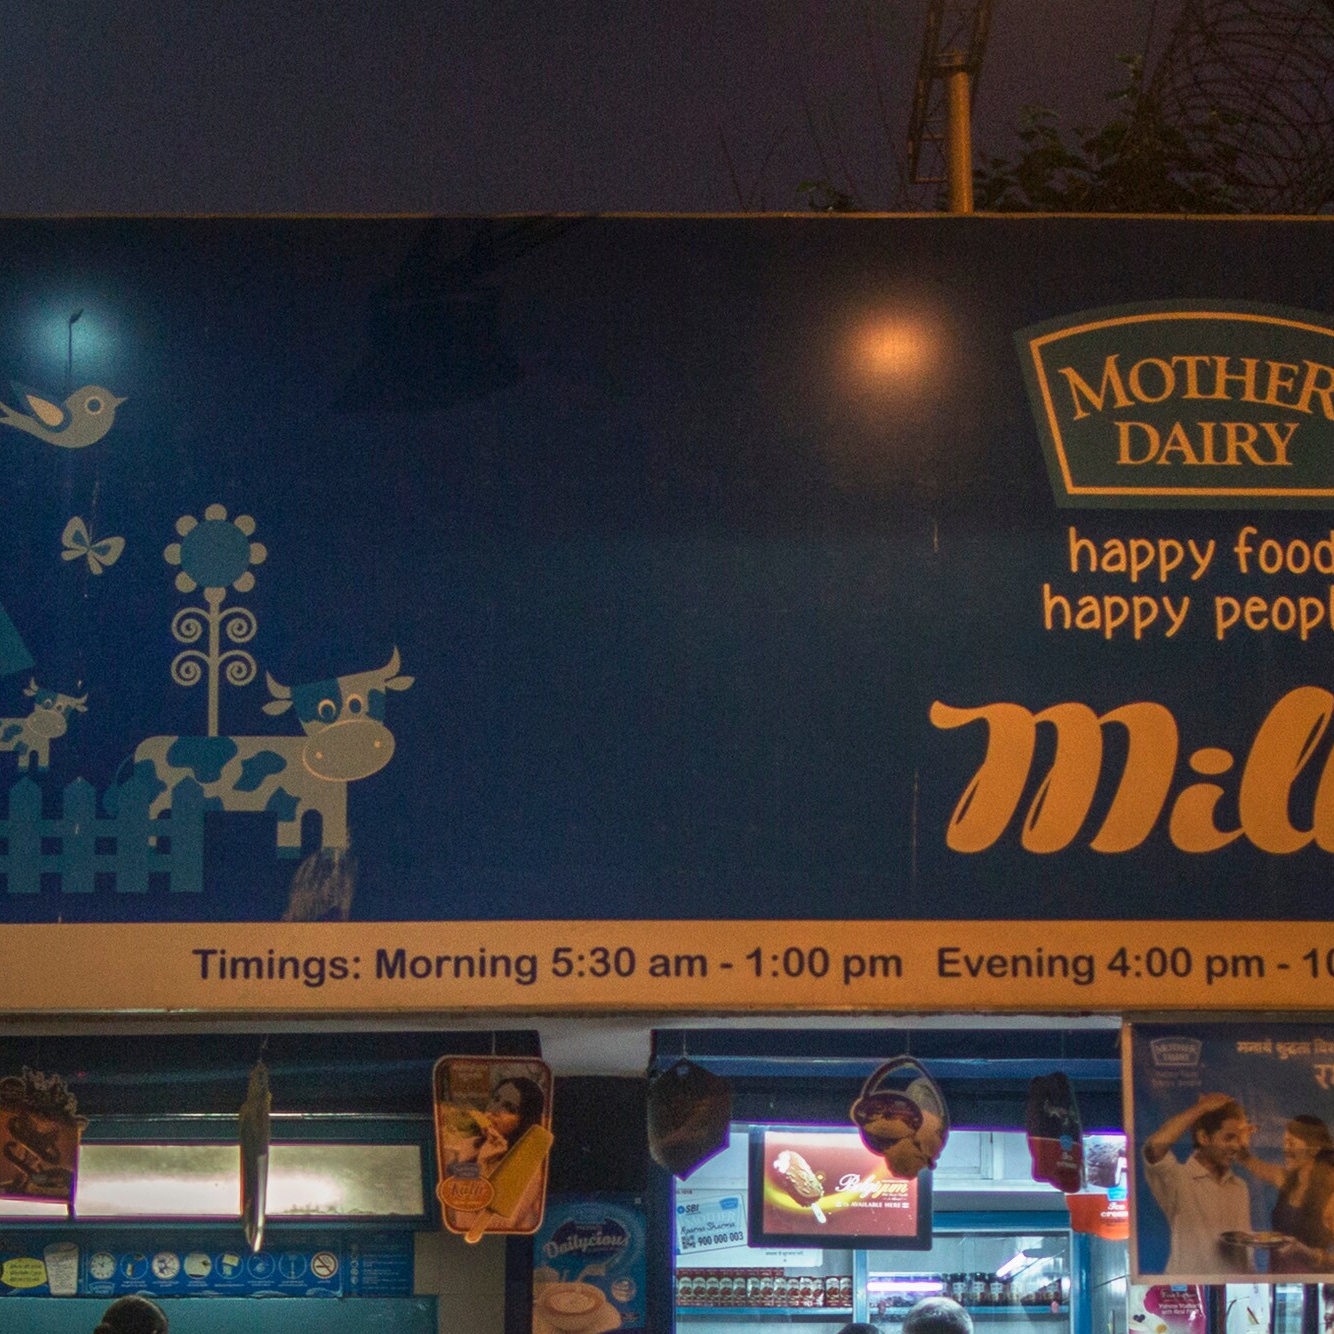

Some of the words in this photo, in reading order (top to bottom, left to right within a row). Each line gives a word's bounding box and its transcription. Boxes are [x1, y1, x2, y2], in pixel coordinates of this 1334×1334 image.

[1113, 420, 1301, 466] DAIRY
[1069, 525, 1216, 583] happy
[1042, 582, 1191, 640] happy
[192, 948, 360, 989] Timings:
[375, 947, 538, 986] Morning
[552, 946, 636, 978] 5:30
[648, 954, 708, 978] am
[746, 946, 830, 979] 1:00
[842, 954, 903, 986] pm
[937, 946, 1096, 986] Evening
[1107, 946, 1193, 978] 4:00
[1205, 954, 1266, 985] pm
[685, 1203, 700, 1214] SBI
[698, 1235, 712, 1246] 900
[713, 1233, 728, 1244] 000
[729, 1231, 744, 1242] 003
